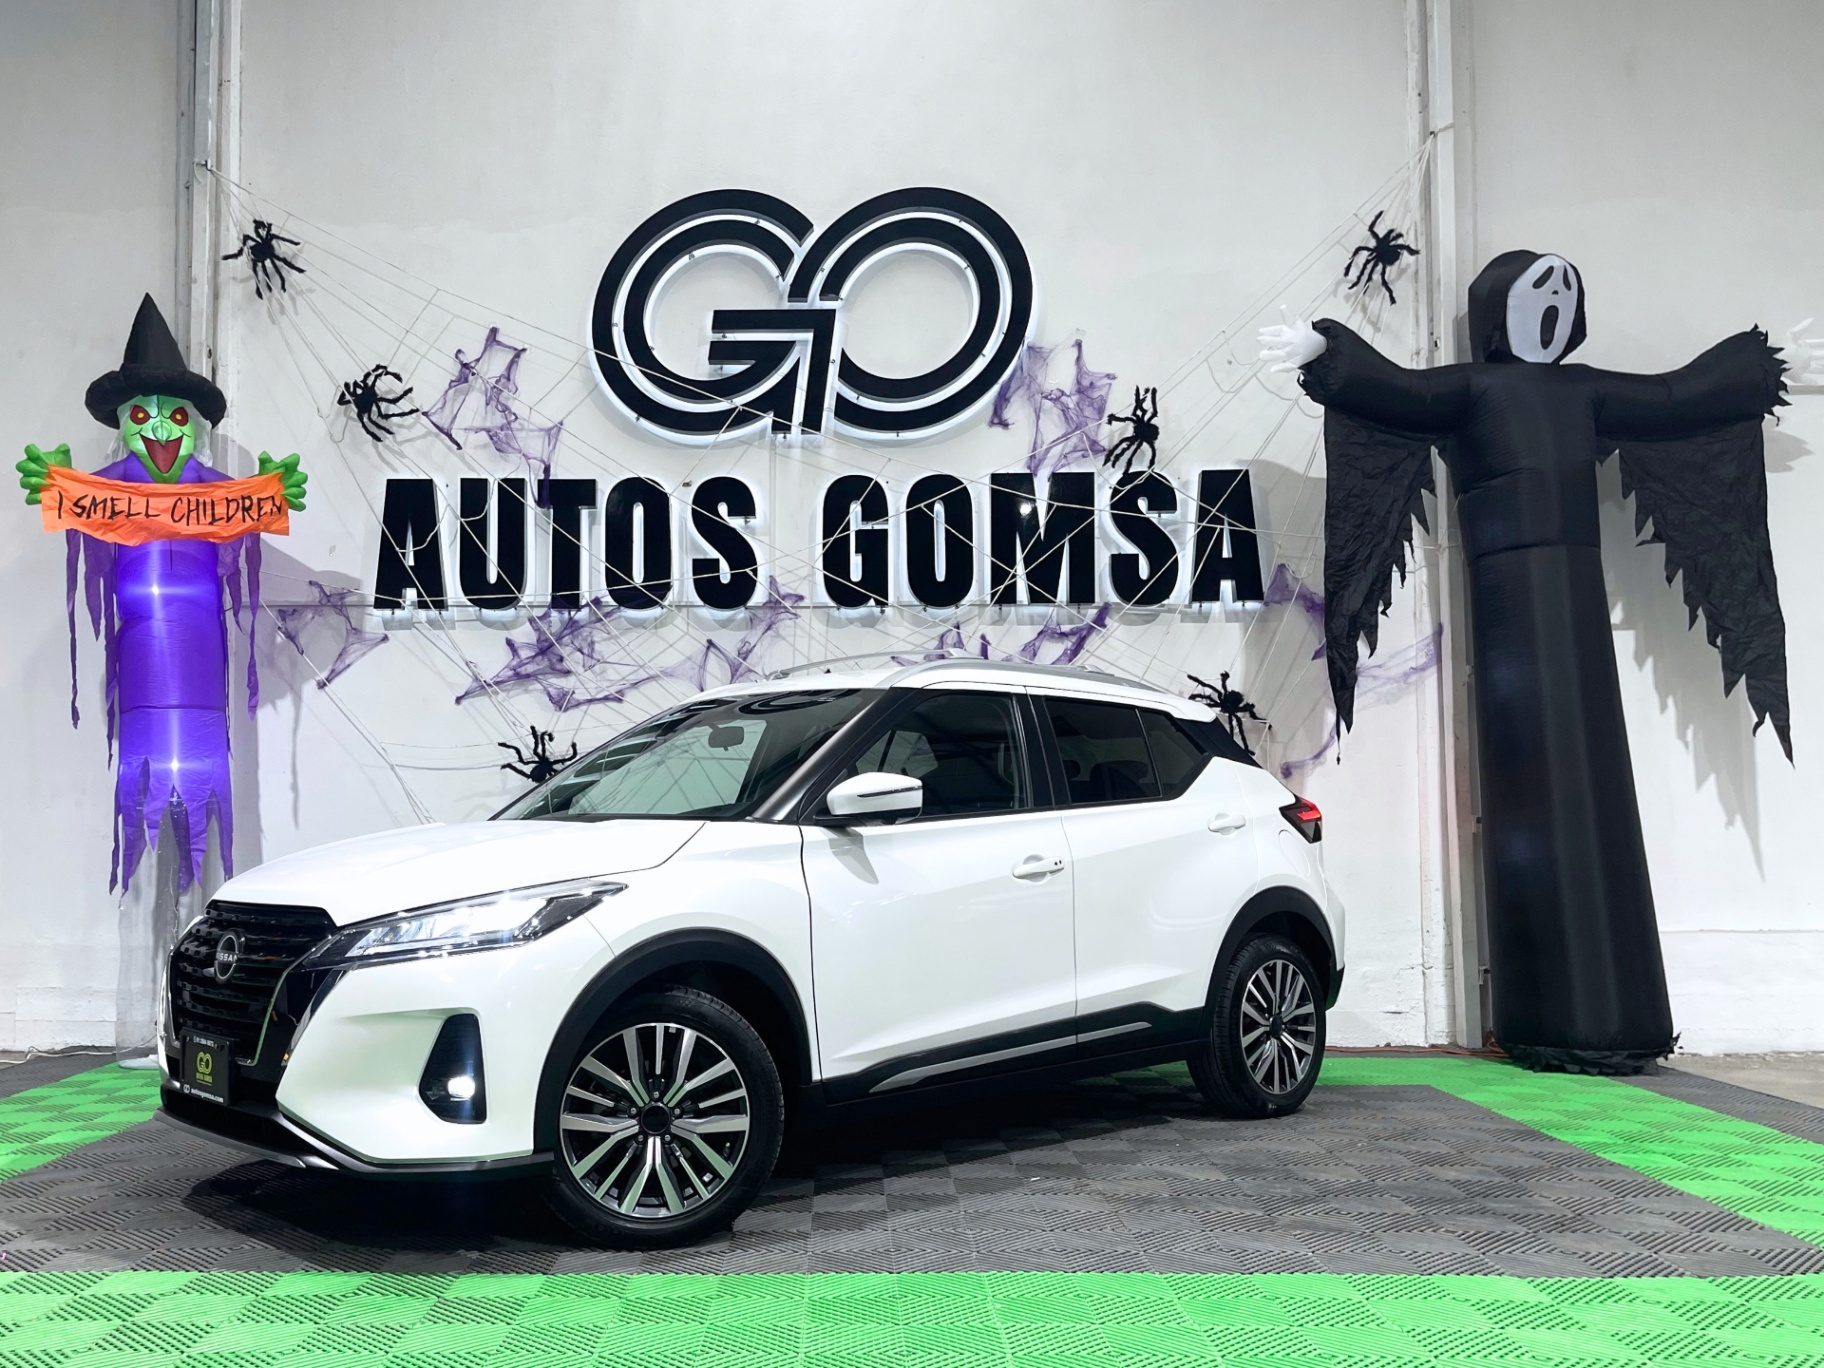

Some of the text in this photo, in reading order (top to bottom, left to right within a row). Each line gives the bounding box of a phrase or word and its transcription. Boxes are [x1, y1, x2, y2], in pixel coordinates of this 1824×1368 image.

[591, 187, 1034, 434] GO
[57, 490, 284, 526] I SMELL CHILDREN
[374, 470, 1266, 611] AUTOS GOMSA
[216, 952, 238, 962] SSAN
